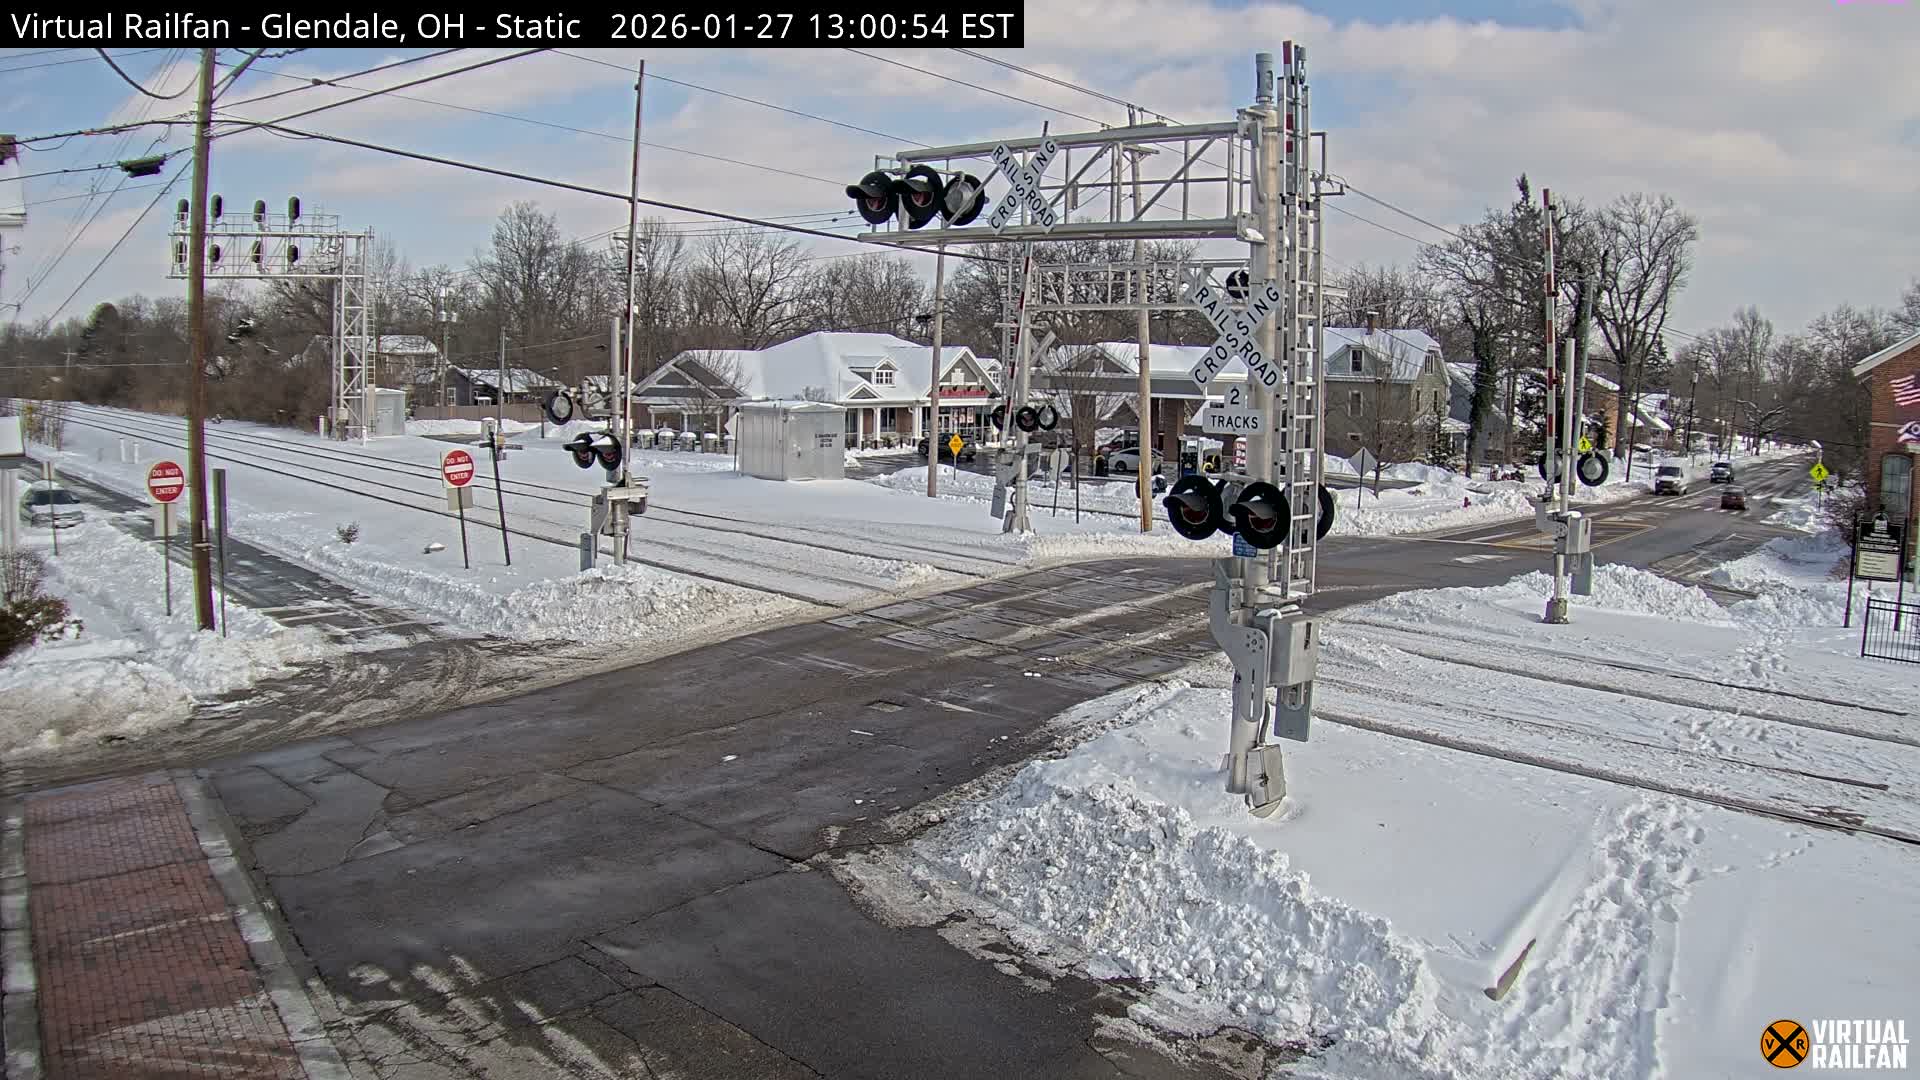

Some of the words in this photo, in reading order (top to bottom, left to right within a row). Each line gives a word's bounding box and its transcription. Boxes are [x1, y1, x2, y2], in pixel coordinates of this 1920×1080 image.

[991, 140, 1055, 229] CROSSING
[993, 145, 1054, 227] RAILROAD
[1194, 286, 1280, 384] CROSSING
[1195, 286, 1278, 387] RAILROAD
[1230, 388, 1240, 405] 2
[1210, 414, 1259, 430] TRACKS
[447, 457, 455, 465] DO
[456, 455, 469, 463] NOT
[152, 469, 162, 477] DO
[165, 468, 179, 476] NOT
[450, 472, 468, 481] ENTER
[155, 486, 177, 495] ENTER
